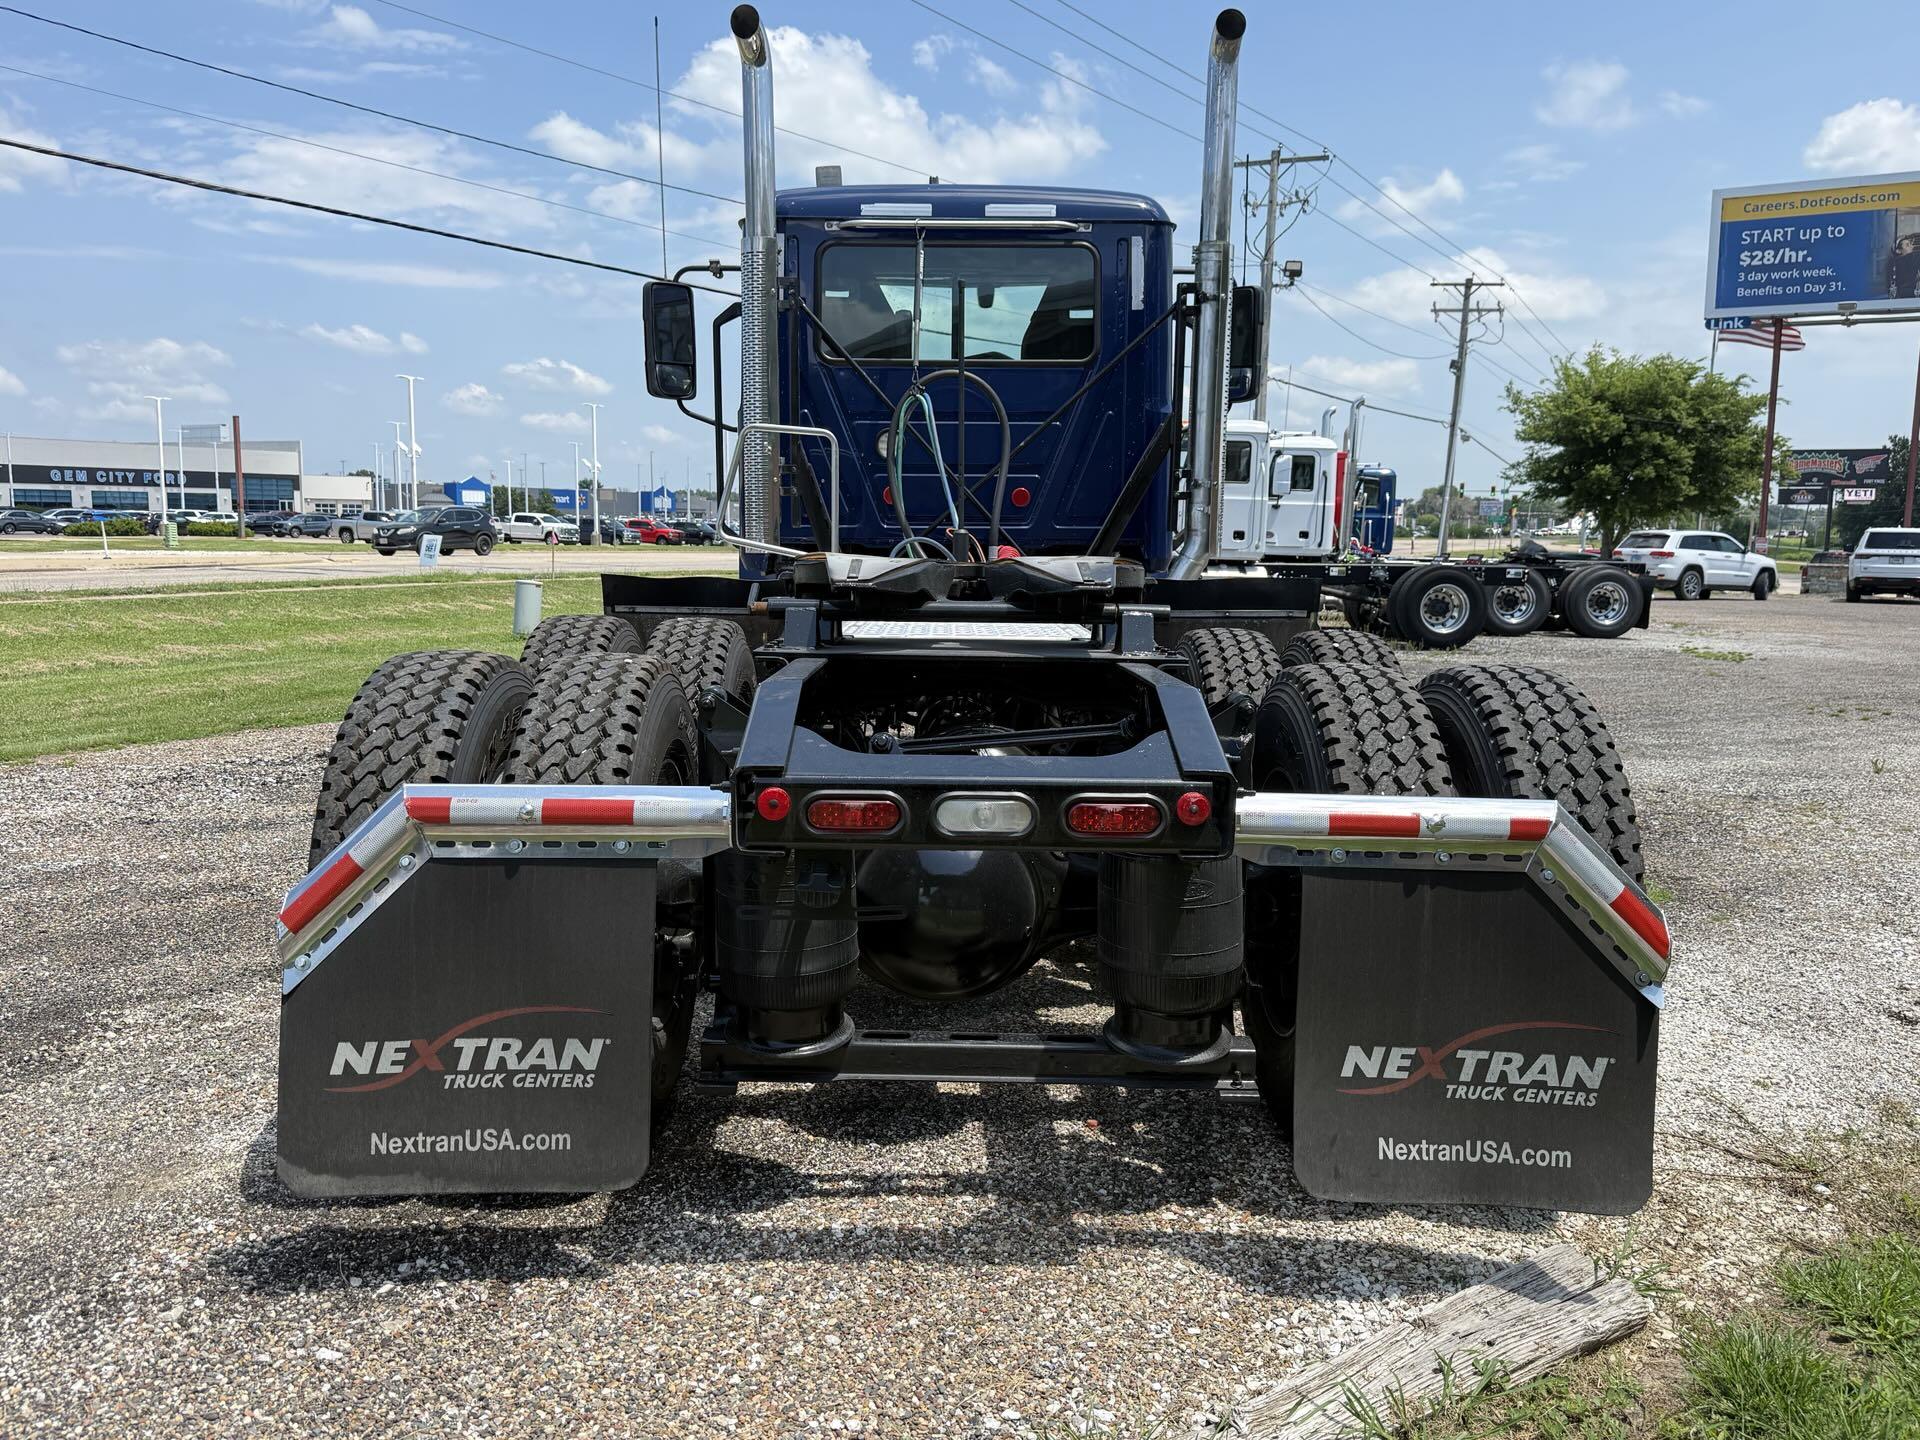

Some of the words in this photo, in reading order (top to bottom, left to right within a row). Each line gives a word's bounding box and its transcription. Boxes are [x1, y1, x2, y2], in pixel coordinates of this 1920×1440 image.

[1743, 191, 1900, 214] Careers.DotFoods.com
[1740, 227, 1795, 245] START
[1799, 228, 1822, 243] up
[1827, 225, 1846, 238] to
[1739, 248, 1813, 267] $28/hr.
[1737, 272, 1745, 282] 3
[1747, 270, 1769, 284] day
[1770, 268, 1800, 280] work
[1802, 266, 1836, 278] week.
[1736, 284, 1783, 297] Benefits
[1785, 285, 1800, 294] on
[1803, 282, 1827, 295] Day
[1828, 281, 1846, 292] 31.
[1710, 317, 1744, 330] Link
[50, 469, 88, 482] GEM
[96, 470, 136, 483] CITY
[143, 472, 187, 485] FORD
[1846, 489, 1873, 497] YETI
[329, 1037, 605, 1076] NEXTRAN
[1340, 1045, 1611, 1090] NEXTRAN
[443, 1073, 507, 1090] TRUCK
[512, 1073, 596, 1089] CENTERS
[1445, 1084, 1505, 1102] TRUCK
[1512, 1087, 1599, 1108] CENTERS
[370, 1128, 572, 1155] NextranUSA.com
[1377, 1137, 1572, 1169] NextranUSA.com
